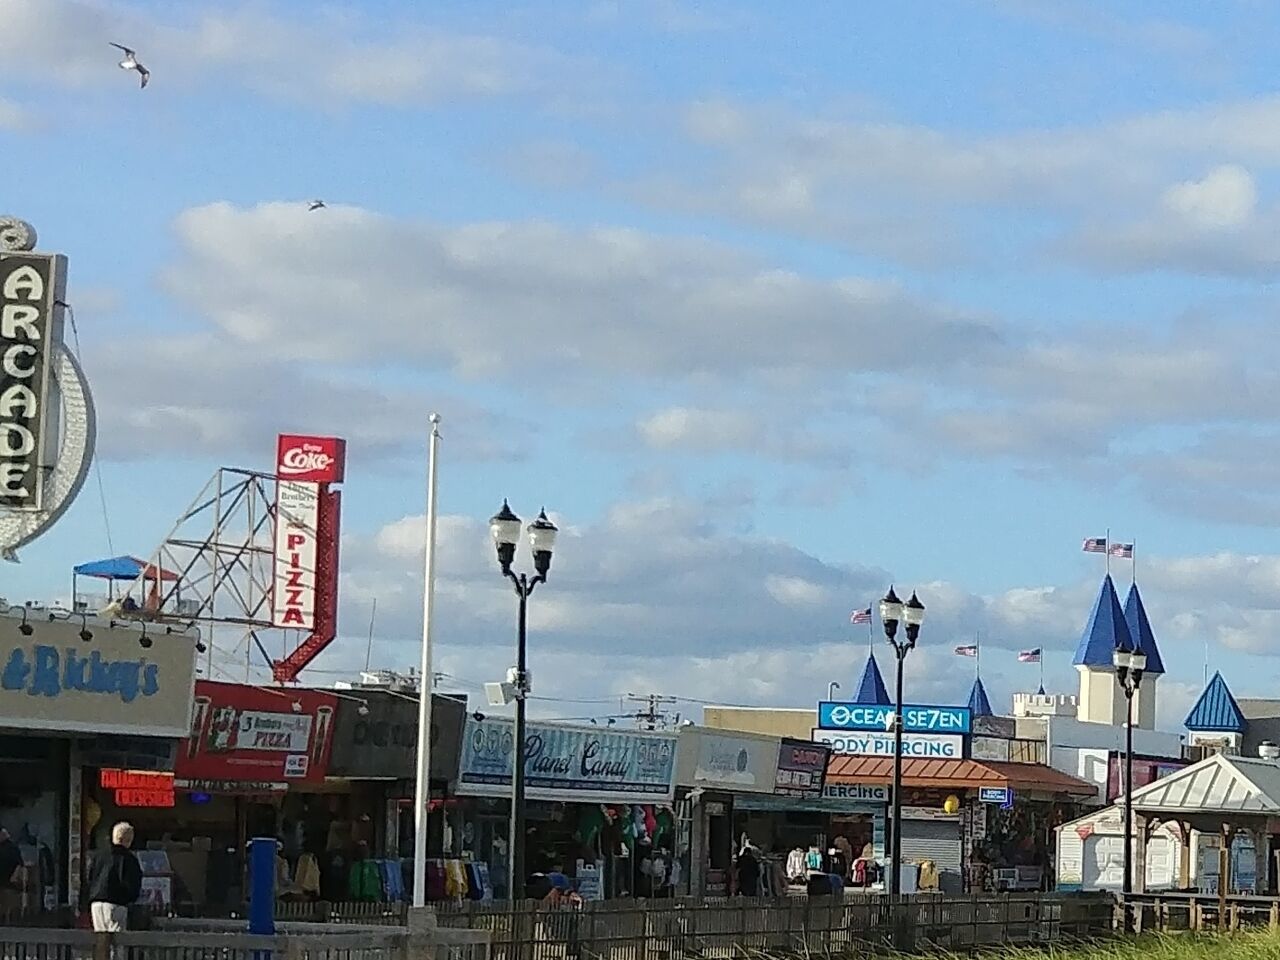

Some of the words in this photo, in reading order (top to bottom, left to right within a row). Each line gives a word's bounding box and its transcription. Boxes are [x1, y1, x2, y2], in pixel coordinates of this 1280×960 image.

[0, 265, 44, 497] ARCADE
[281, 448, 334, 474] Coke
[281, 533, 306, 625] PIZZA
[831, 705, 903, 727] OCEA
[907, 710, 963, 729] SE7EN
[252, 731, 291, 748] PIZZA
[524, 733, 576, 774] Planet
[580, 739, 632, 782] Candy
[823, 785, 885, 800] IERCING
